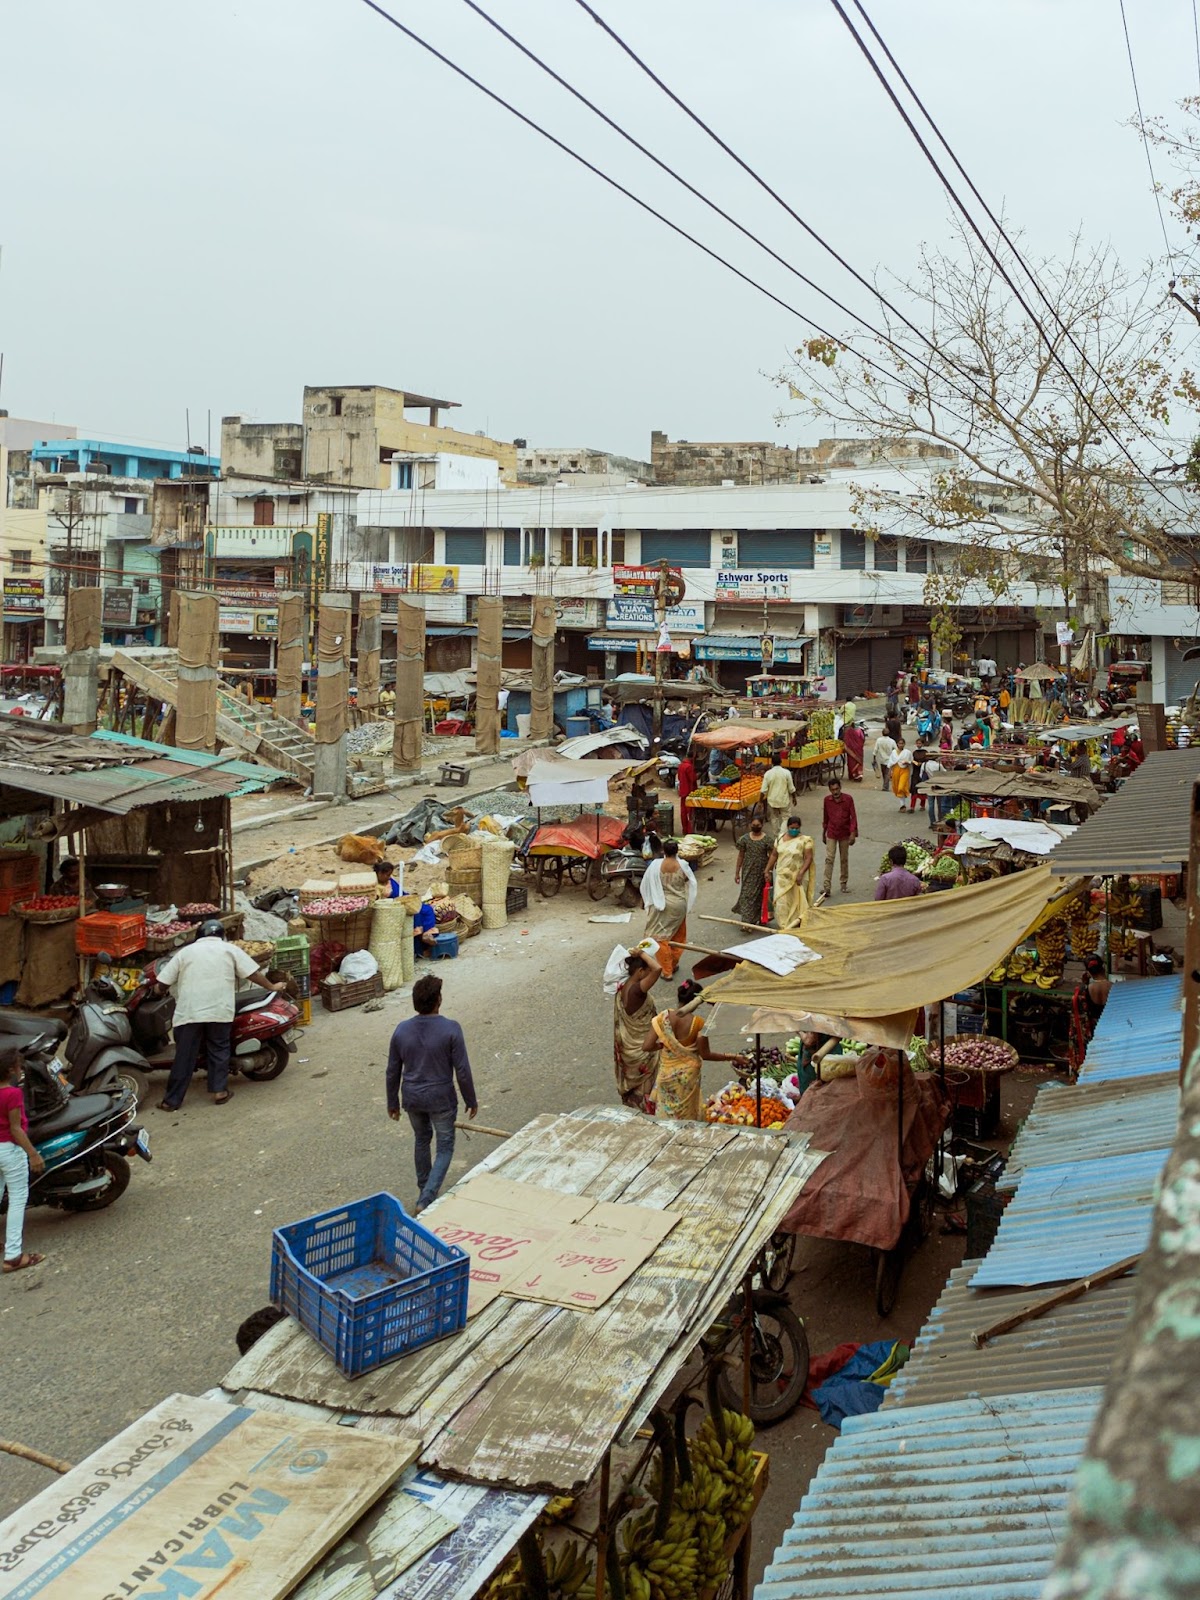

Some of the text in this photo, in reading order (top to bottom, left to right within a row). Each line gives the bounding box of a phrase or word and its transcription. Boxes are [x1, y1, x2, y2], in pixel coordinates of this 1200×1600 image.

[718, 572, 788, 583] Eshwar Sports
[619, 605, 647, 613] VIJAYA
[615, 613, 653, 621] CREATIONS
[117, 1485, 155, 1518] MAK
[77, 1517, 114, 1547] makes
[133, 1486, 292, 1600] MAK
[66, 1546, 79, 1558] it
